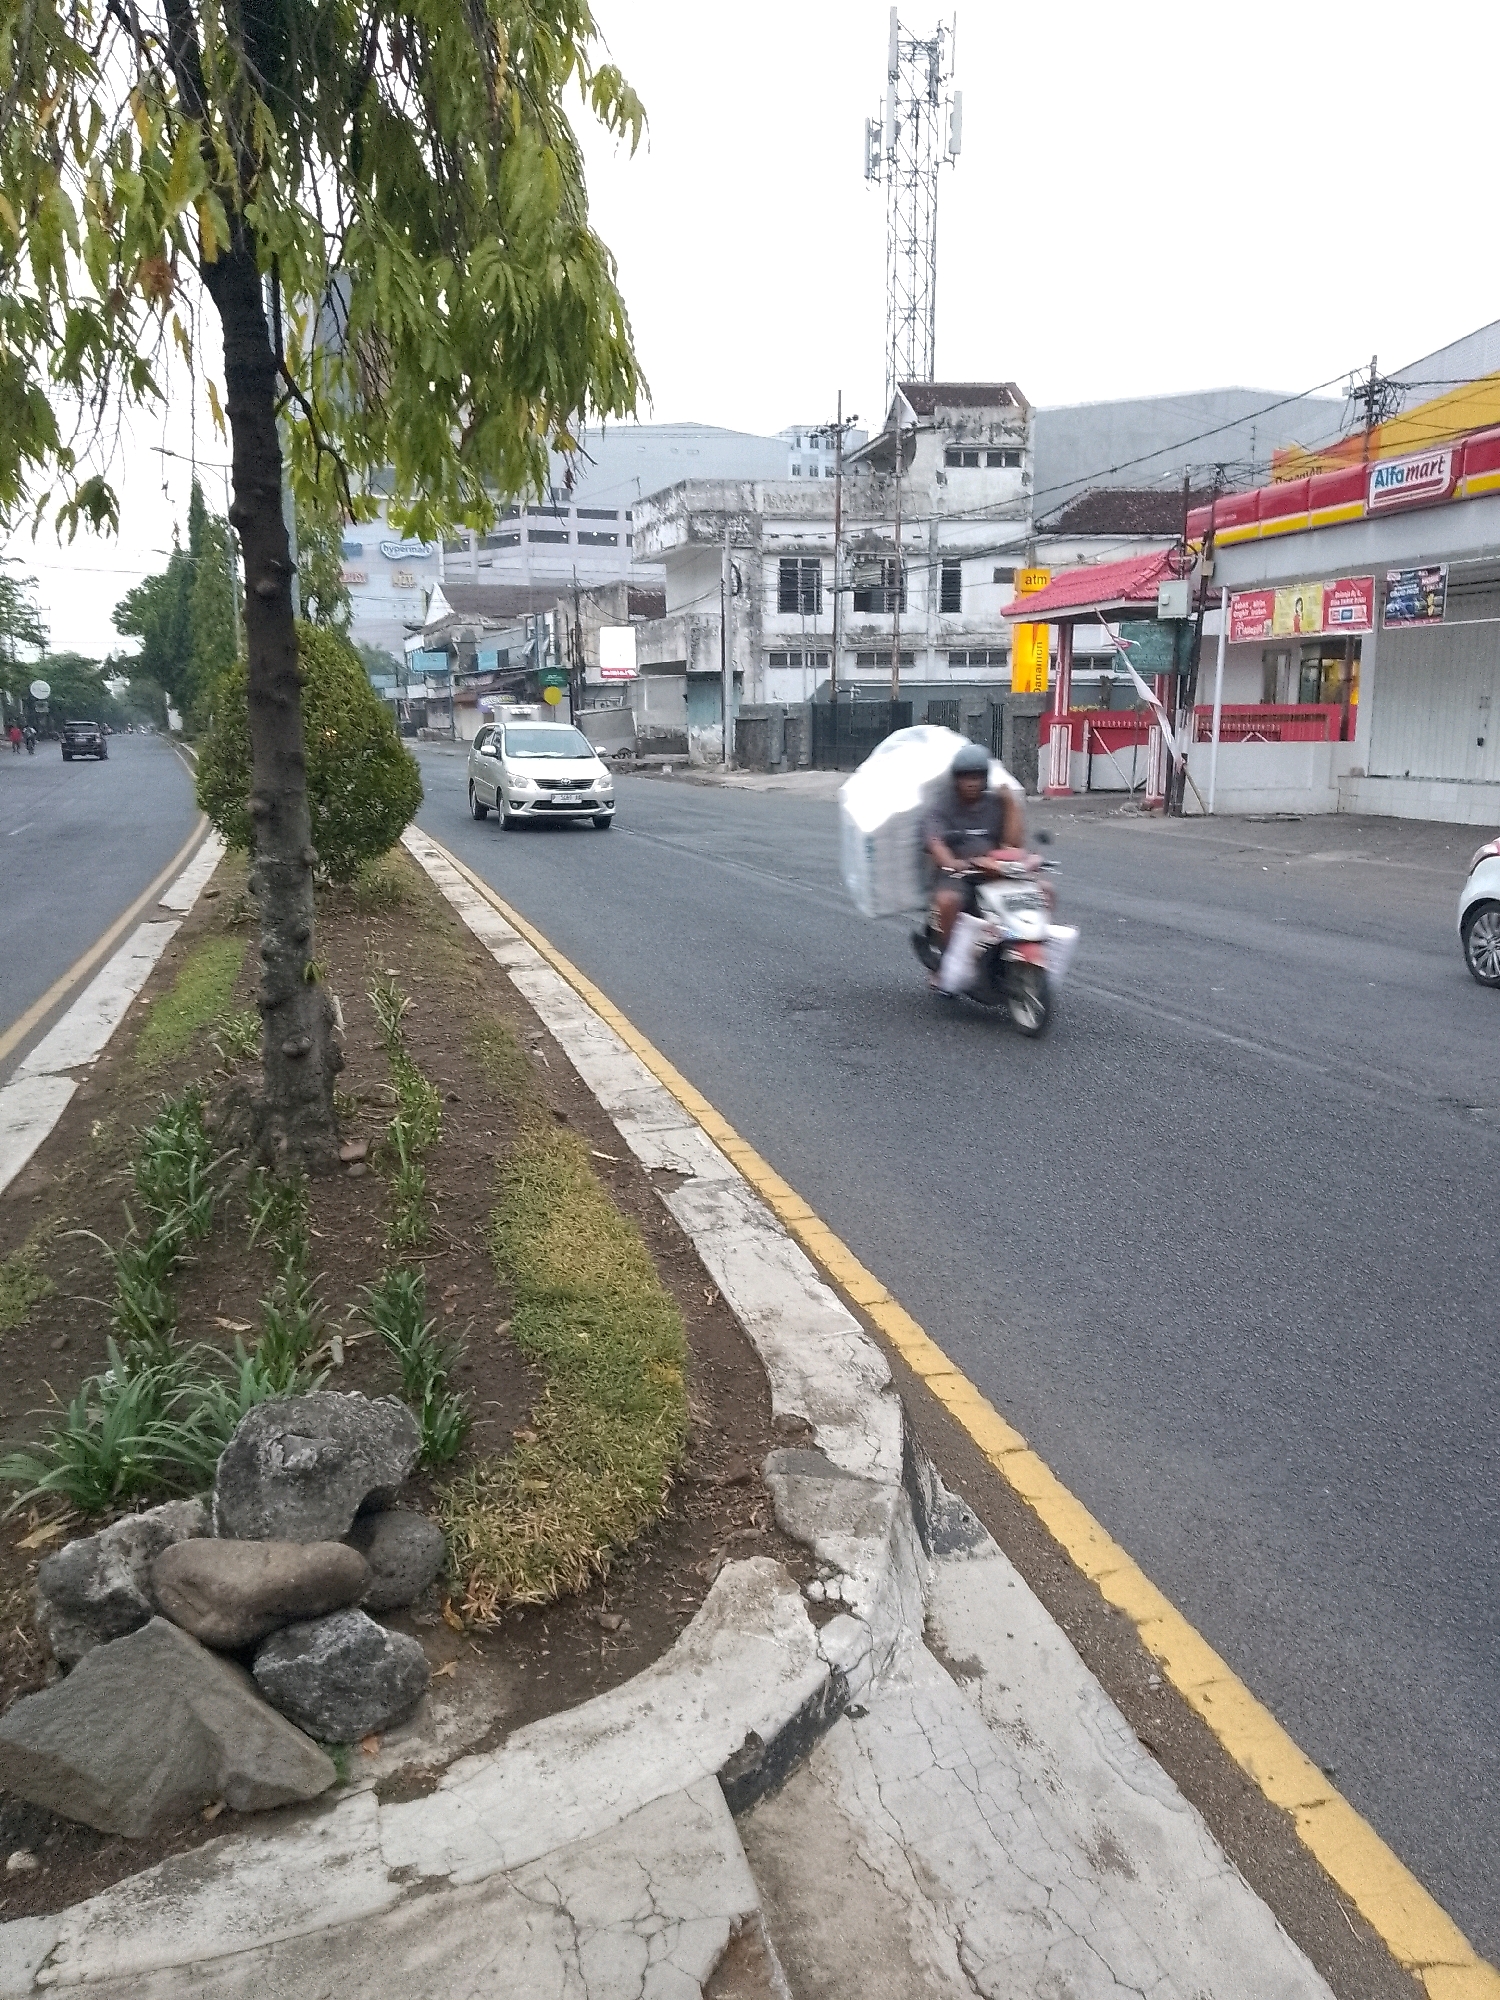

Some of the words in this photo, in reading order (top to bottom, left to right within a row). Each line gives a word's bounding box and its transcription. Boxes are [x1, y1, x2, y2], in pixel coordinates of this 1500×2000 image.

[1374, 455, 1446, 488] Alfamart
[1025, 574, 1047, 585] atm
[1033, 641, 1042, 693] Danamon
